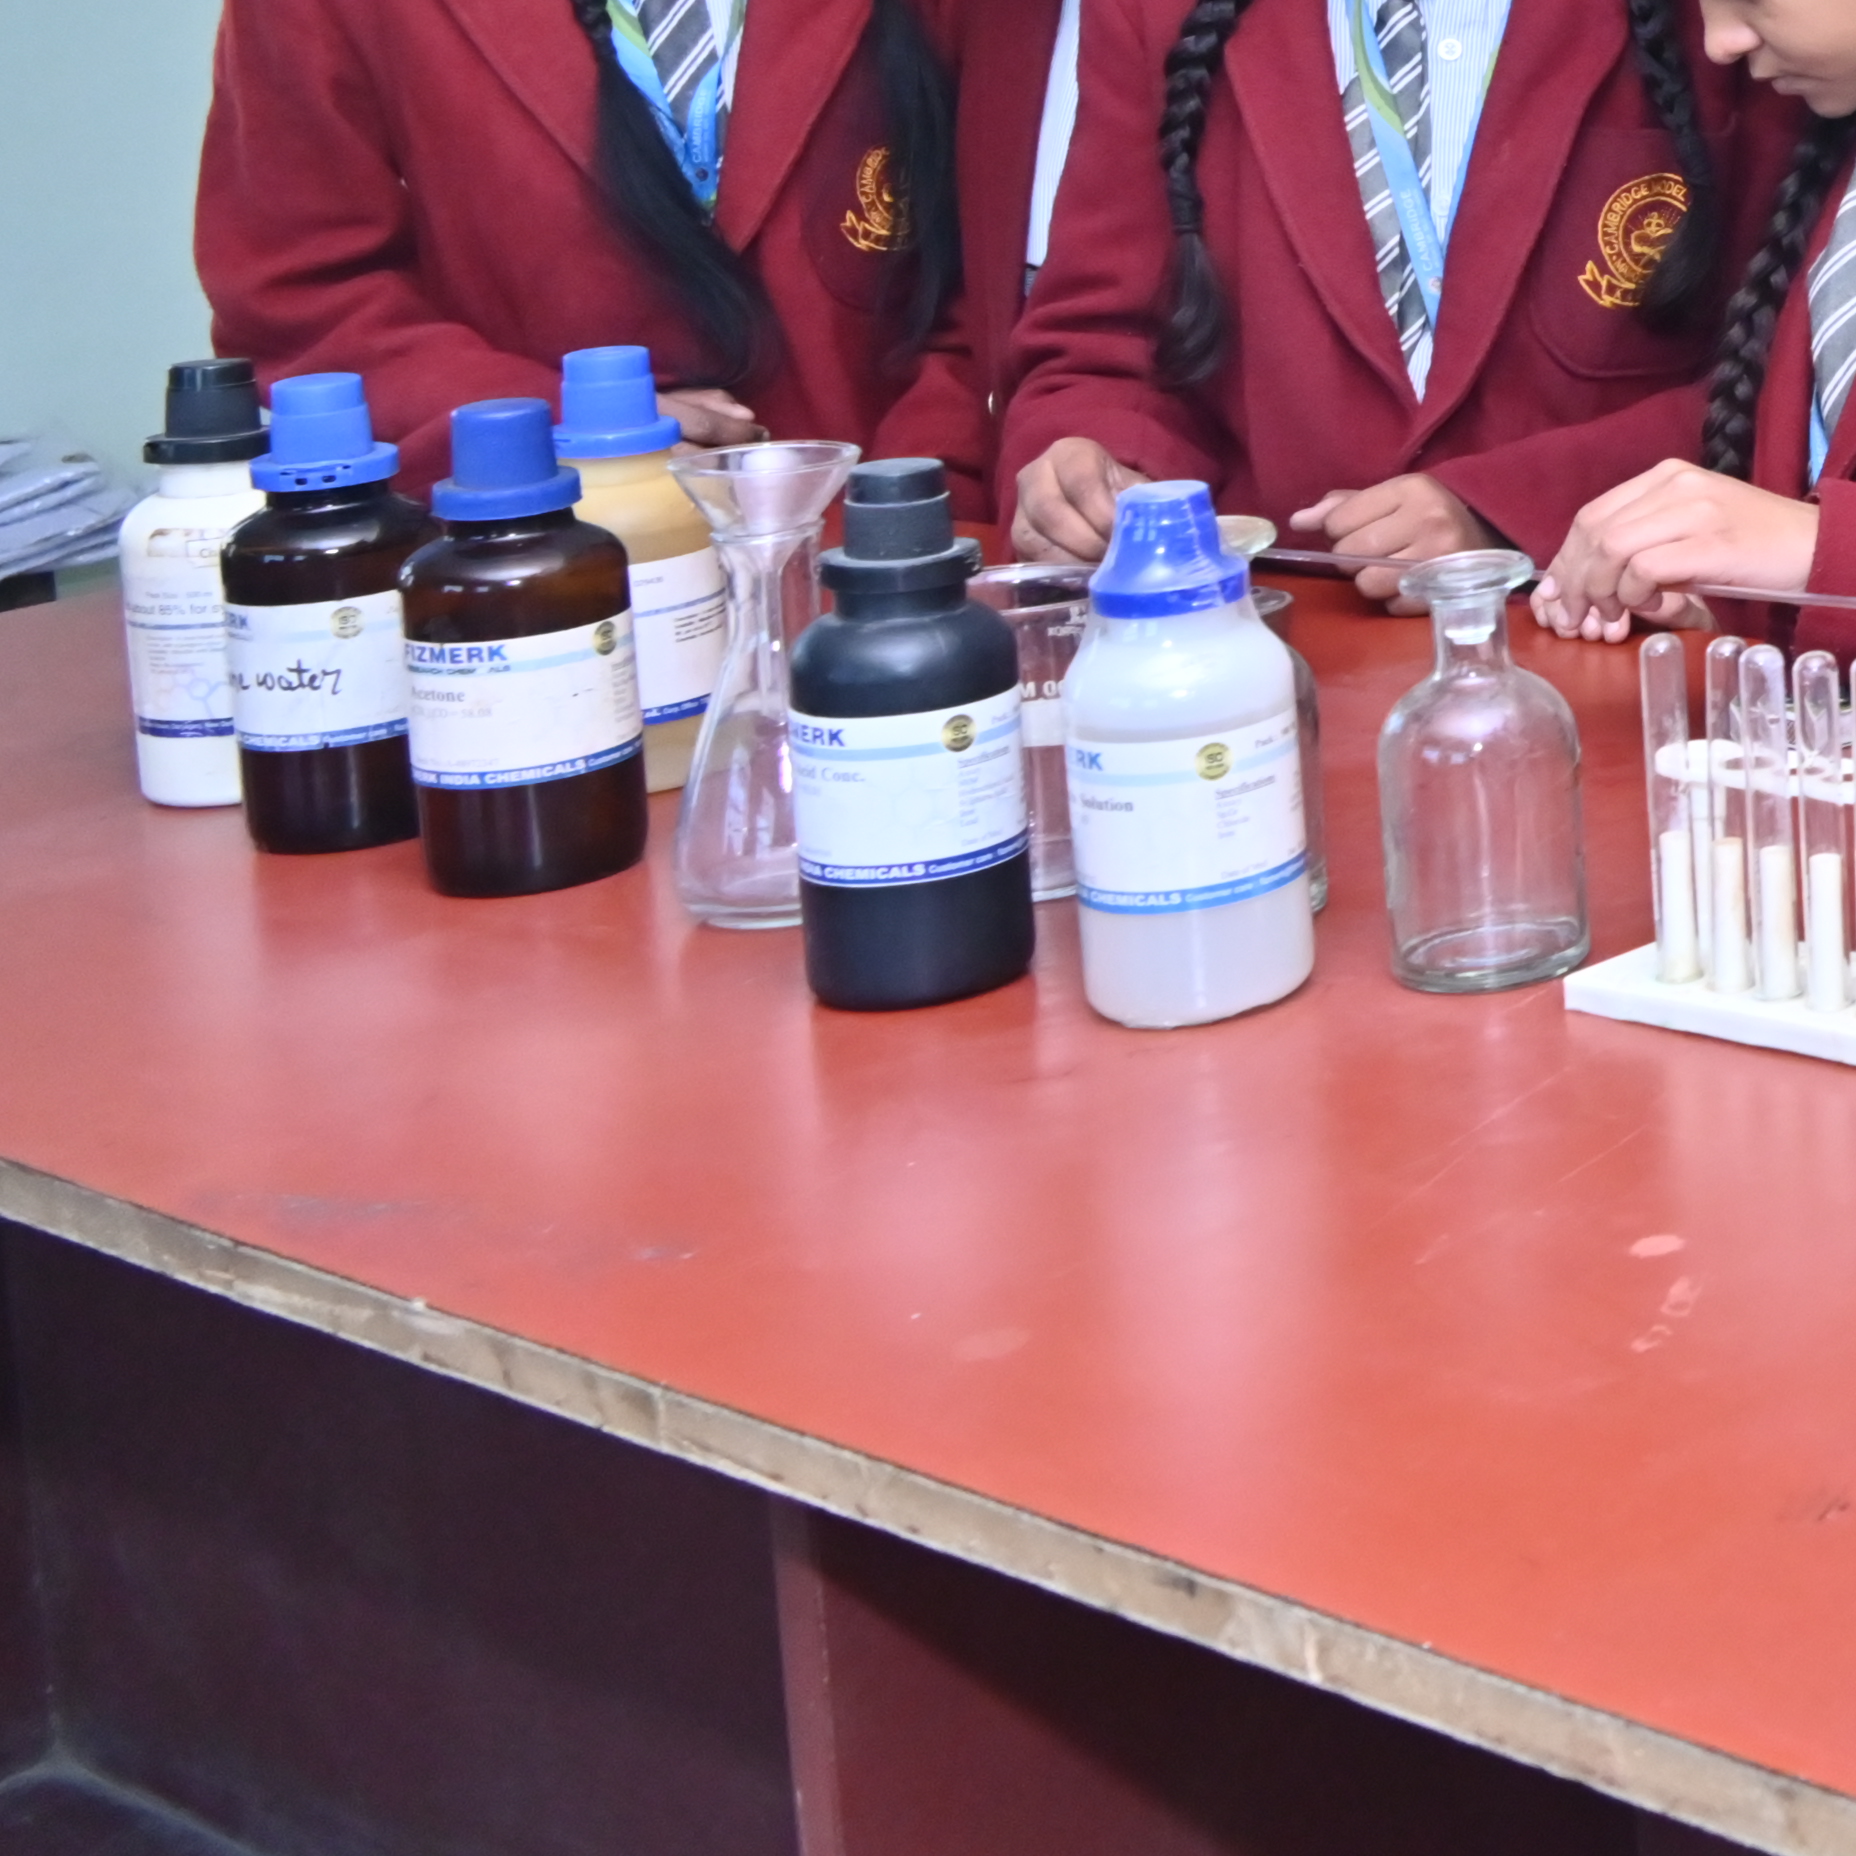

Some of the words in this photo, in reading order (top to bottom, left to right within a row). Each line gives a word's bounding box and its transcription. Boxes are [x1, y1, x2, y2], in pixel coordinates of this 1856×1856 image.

[1603, 184, 1649, 255] CAMBRIDGE
[1400, 188, 1433, 271] CAMBRIDGE
[158, 604, 186, 615] 85%
[190, 604, 207, 615] for
[406, 644, 507, 664] FIZMERK
[256, 658, 342, 695] water
[411, 685, 466, 703] Acetone
[243, 734, 321, 747] CHEMICALS
[440, 771, 481, 786] INDIA
[484, 759, 586, 785] CHEMICALS
[821, 767, 866, 783] Conc.
[1080, 795, 1134, 812] Solution
[823, 863, 926, 881] CHEMICALS
[1089, 890, 1182, 907] CHEMICALS
